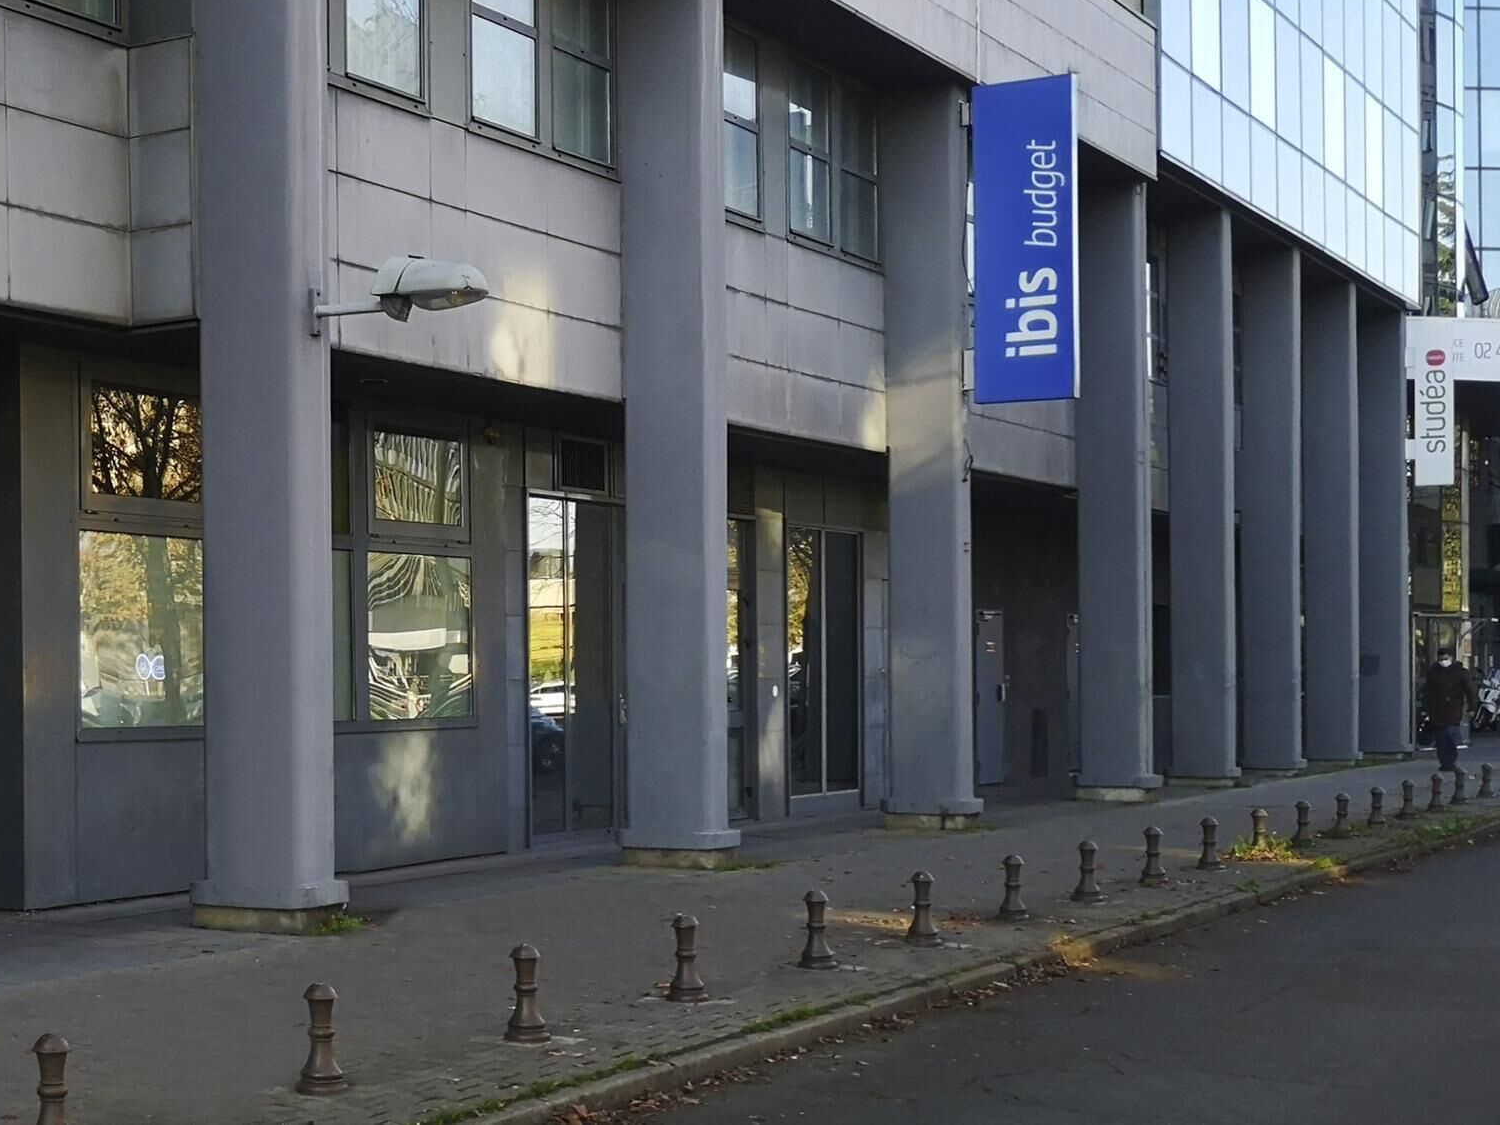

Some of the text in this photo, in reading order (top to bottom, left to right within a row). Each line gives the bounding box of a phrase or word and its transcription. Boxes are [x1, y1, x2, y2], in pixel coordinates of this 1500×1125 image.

[1005, 139, 1066, 357] ibis budget
[1474, 342, 1492, 359] 02
[1420, 369, 1446, 453] studéa
